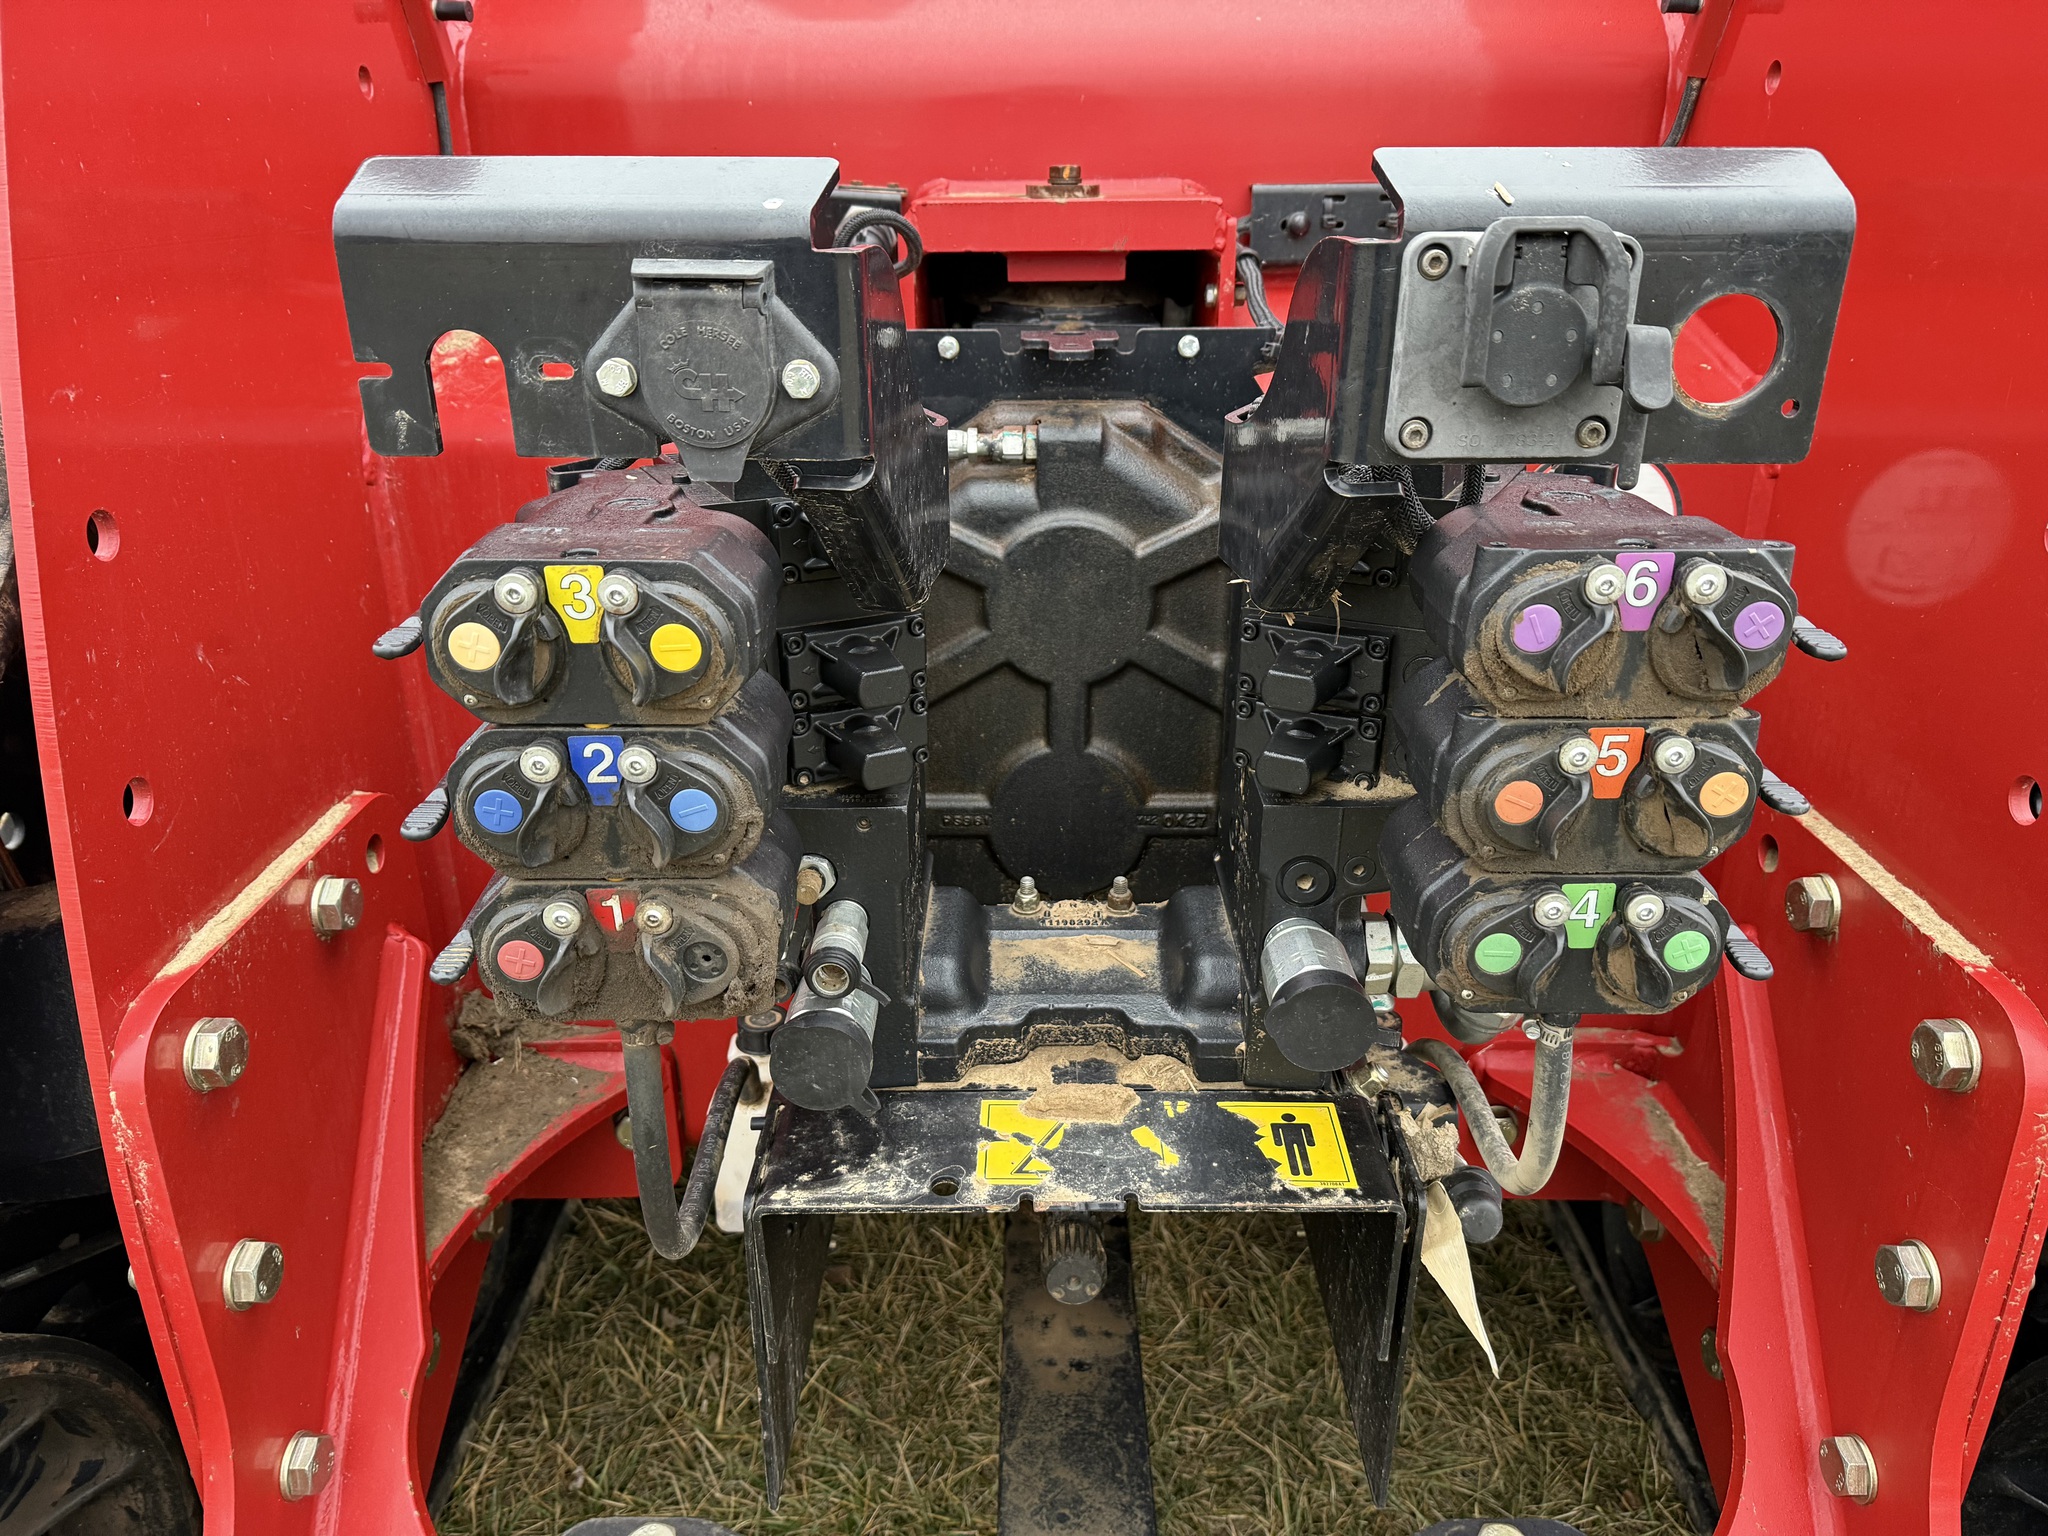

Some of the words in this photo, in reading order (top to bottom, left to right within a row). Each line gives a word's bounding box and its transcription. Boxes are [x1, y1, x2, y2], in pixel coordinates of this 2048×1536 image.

[659, 326, 688, 350] COLE
[696, 325, 742, 350] HERSEE
[666, 412, 716, 439] BOSTON
[723, 416, 751, 436] USA
[559, 573, 597, 621] 3
[1624, 560, 1660, 607] 6
[483, 606, 506, 632] OPEN
[637, 608, 660, 633] OPEN
[583, 742, 619, 783] 2
[1596, 735, 1629, 776] 5
[508, 776, 531, 798] OPEN
[656, 775, 678, 798] OPEN
[602, 894, 624, 931] 1
[1569, 889, 1600, 928] 4
